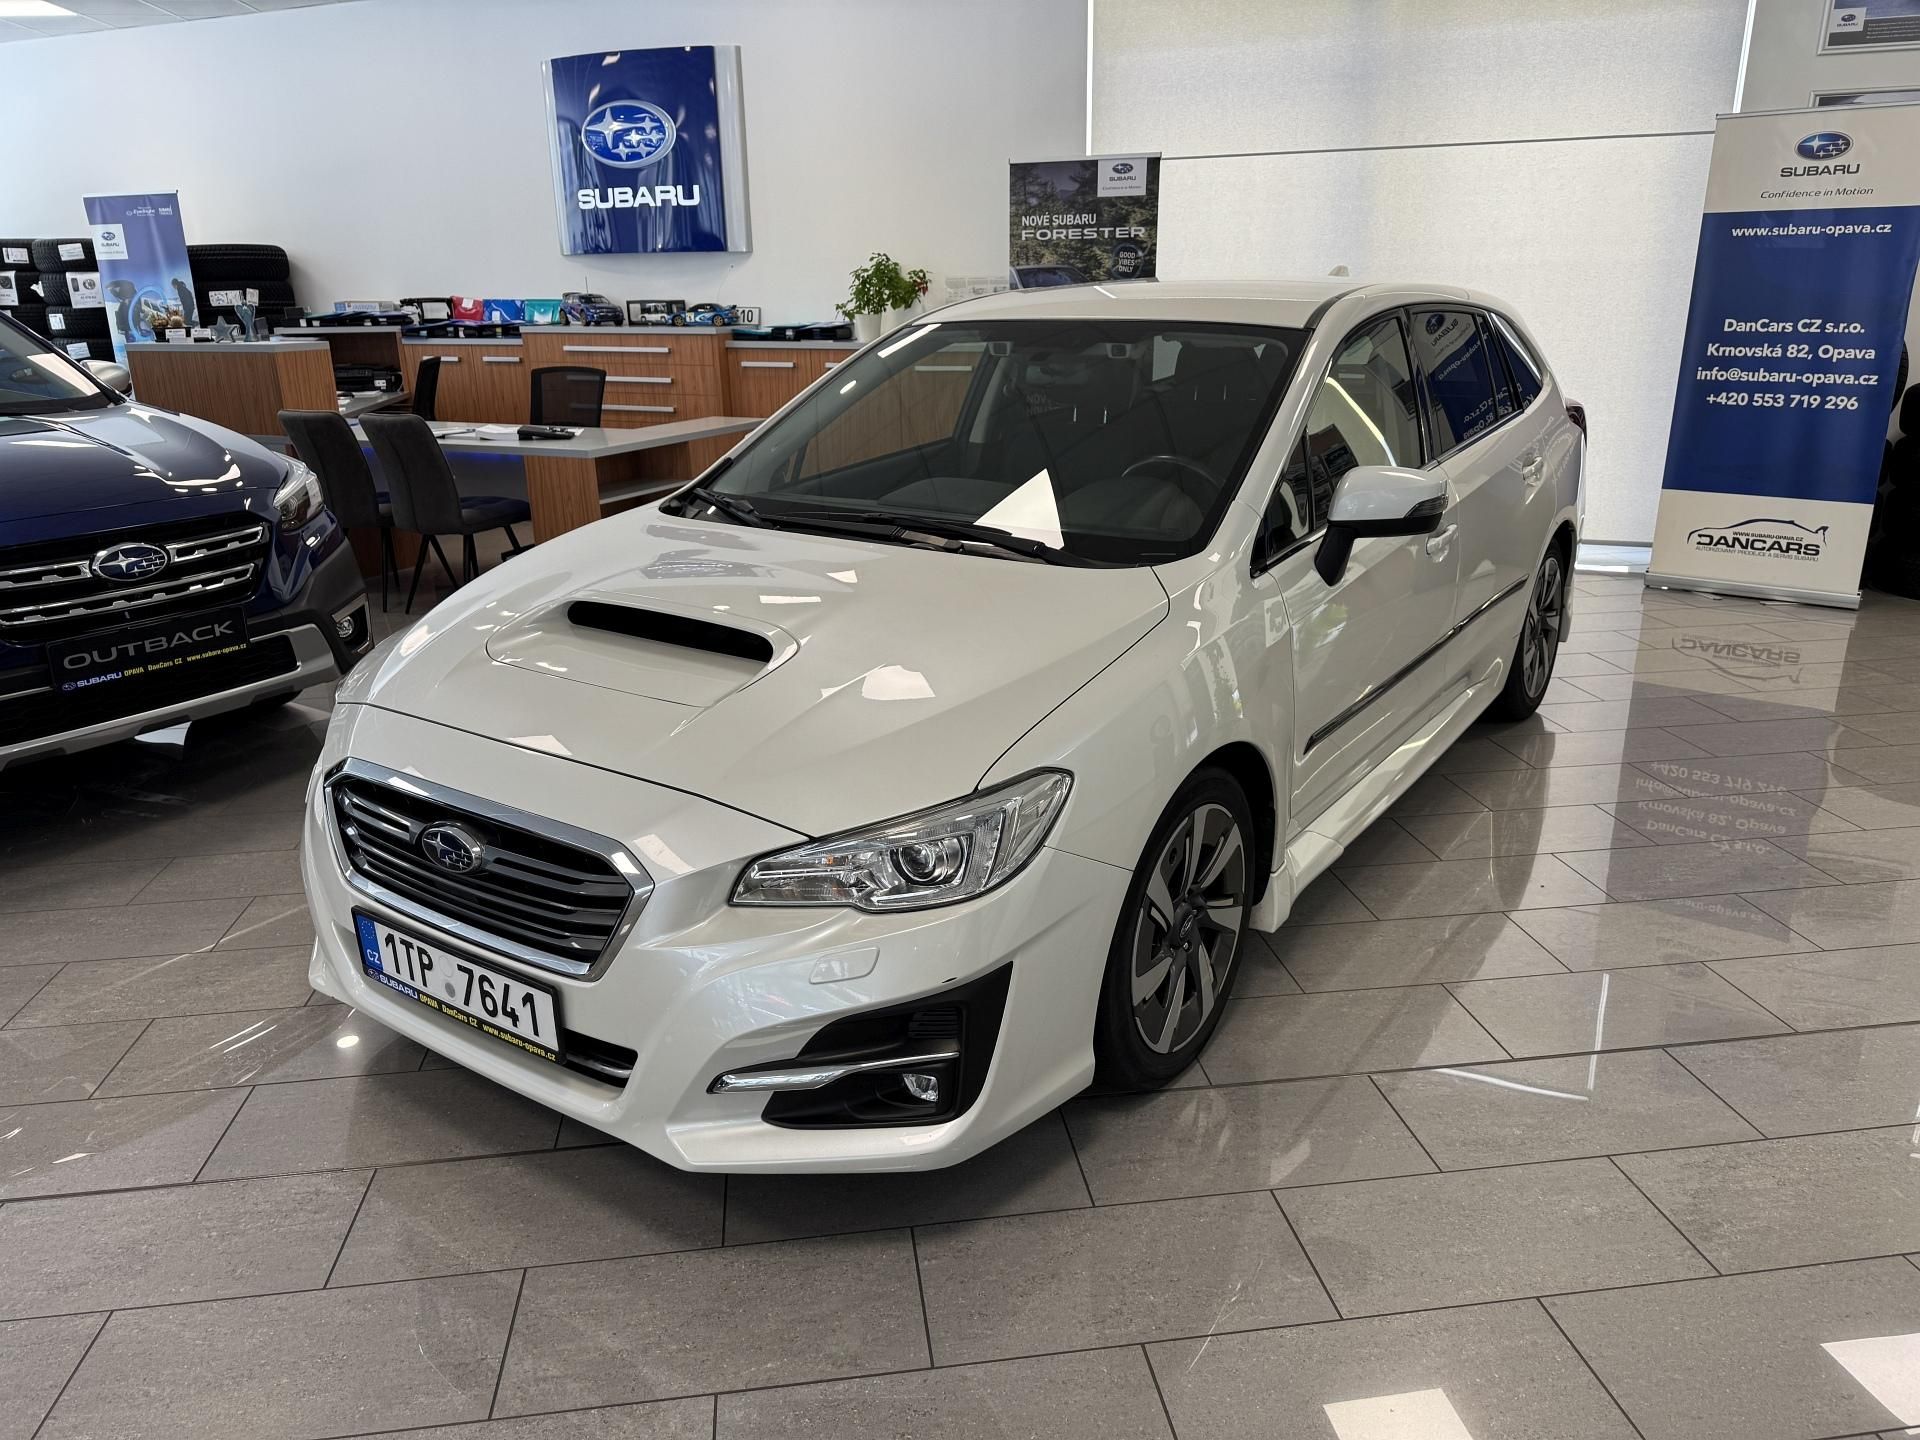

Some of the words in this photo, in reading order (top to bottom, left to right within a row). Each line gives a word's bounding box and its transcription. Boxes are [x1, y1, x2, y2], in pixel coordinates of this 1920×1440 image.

[1780, 164, 1861, 178] SUBARU
[577, 184, 700, 210] SUBARU
[1760, 189, 1821, 199] Confidence
[1823, 188, 1833, 197] in
[1835, 186, 1874, 196] Motion
[1022, 212, 1050, 226] NOVÉ
[1052, 213, 1097, 225] SUBARU
[1021, 226, 1146, 241] FORESTER
[1731, 223, 1892, 237] www.subaru-opava.cz
[1118, 265, 1134, 273] ONLY
[1723, 318, 1793, 333] DanCars
[1797, 318, 1822, 333] CZ
[1824, 320, 1865, 334] s.r.o.
[1707, 342, 1782, 357] Krnovská
[1786, 344, 1813, 360] 82,
[1817, 345, 1876, 362] Opava
[1696, 366, 1879, 387] info@subaru-opava.cz
[1706, 391, 1748, 406] +420
[1752, 393, 1784, 407] 553
[1790, 394, 1821, 409] 719
[1824, 396, 1859, 410] 296
[1696, 533, 1821, 556] DANCARS
[1732, 530, 1804, 542] WWW.SUBARU-OPAVA.CZ
[63, 620, 234, 669] OUTBACK
[77, 671, 122, 688] SUBARU
[124, 667, 144, 677] OPAVA
[147, 661, 173, 671] DanCars
[174, 657, 182, 665] CZ
[186, 643, 247, 662] www.subaru-opava.cz
[366, 949, 381, 964] CZ
[385, 932, 434, 988] 1TP
[456, 963, 540, 1037] 7641
[379, 974, 418, 999] SUBARU
[419, 994, 439, 1009] OPAVA
[442, 1004, 468, 1023] DanCars
[469, 1017, 479, 1028] CZ
[482, 1023, 556, 1062] www.subaru-opava.cz
